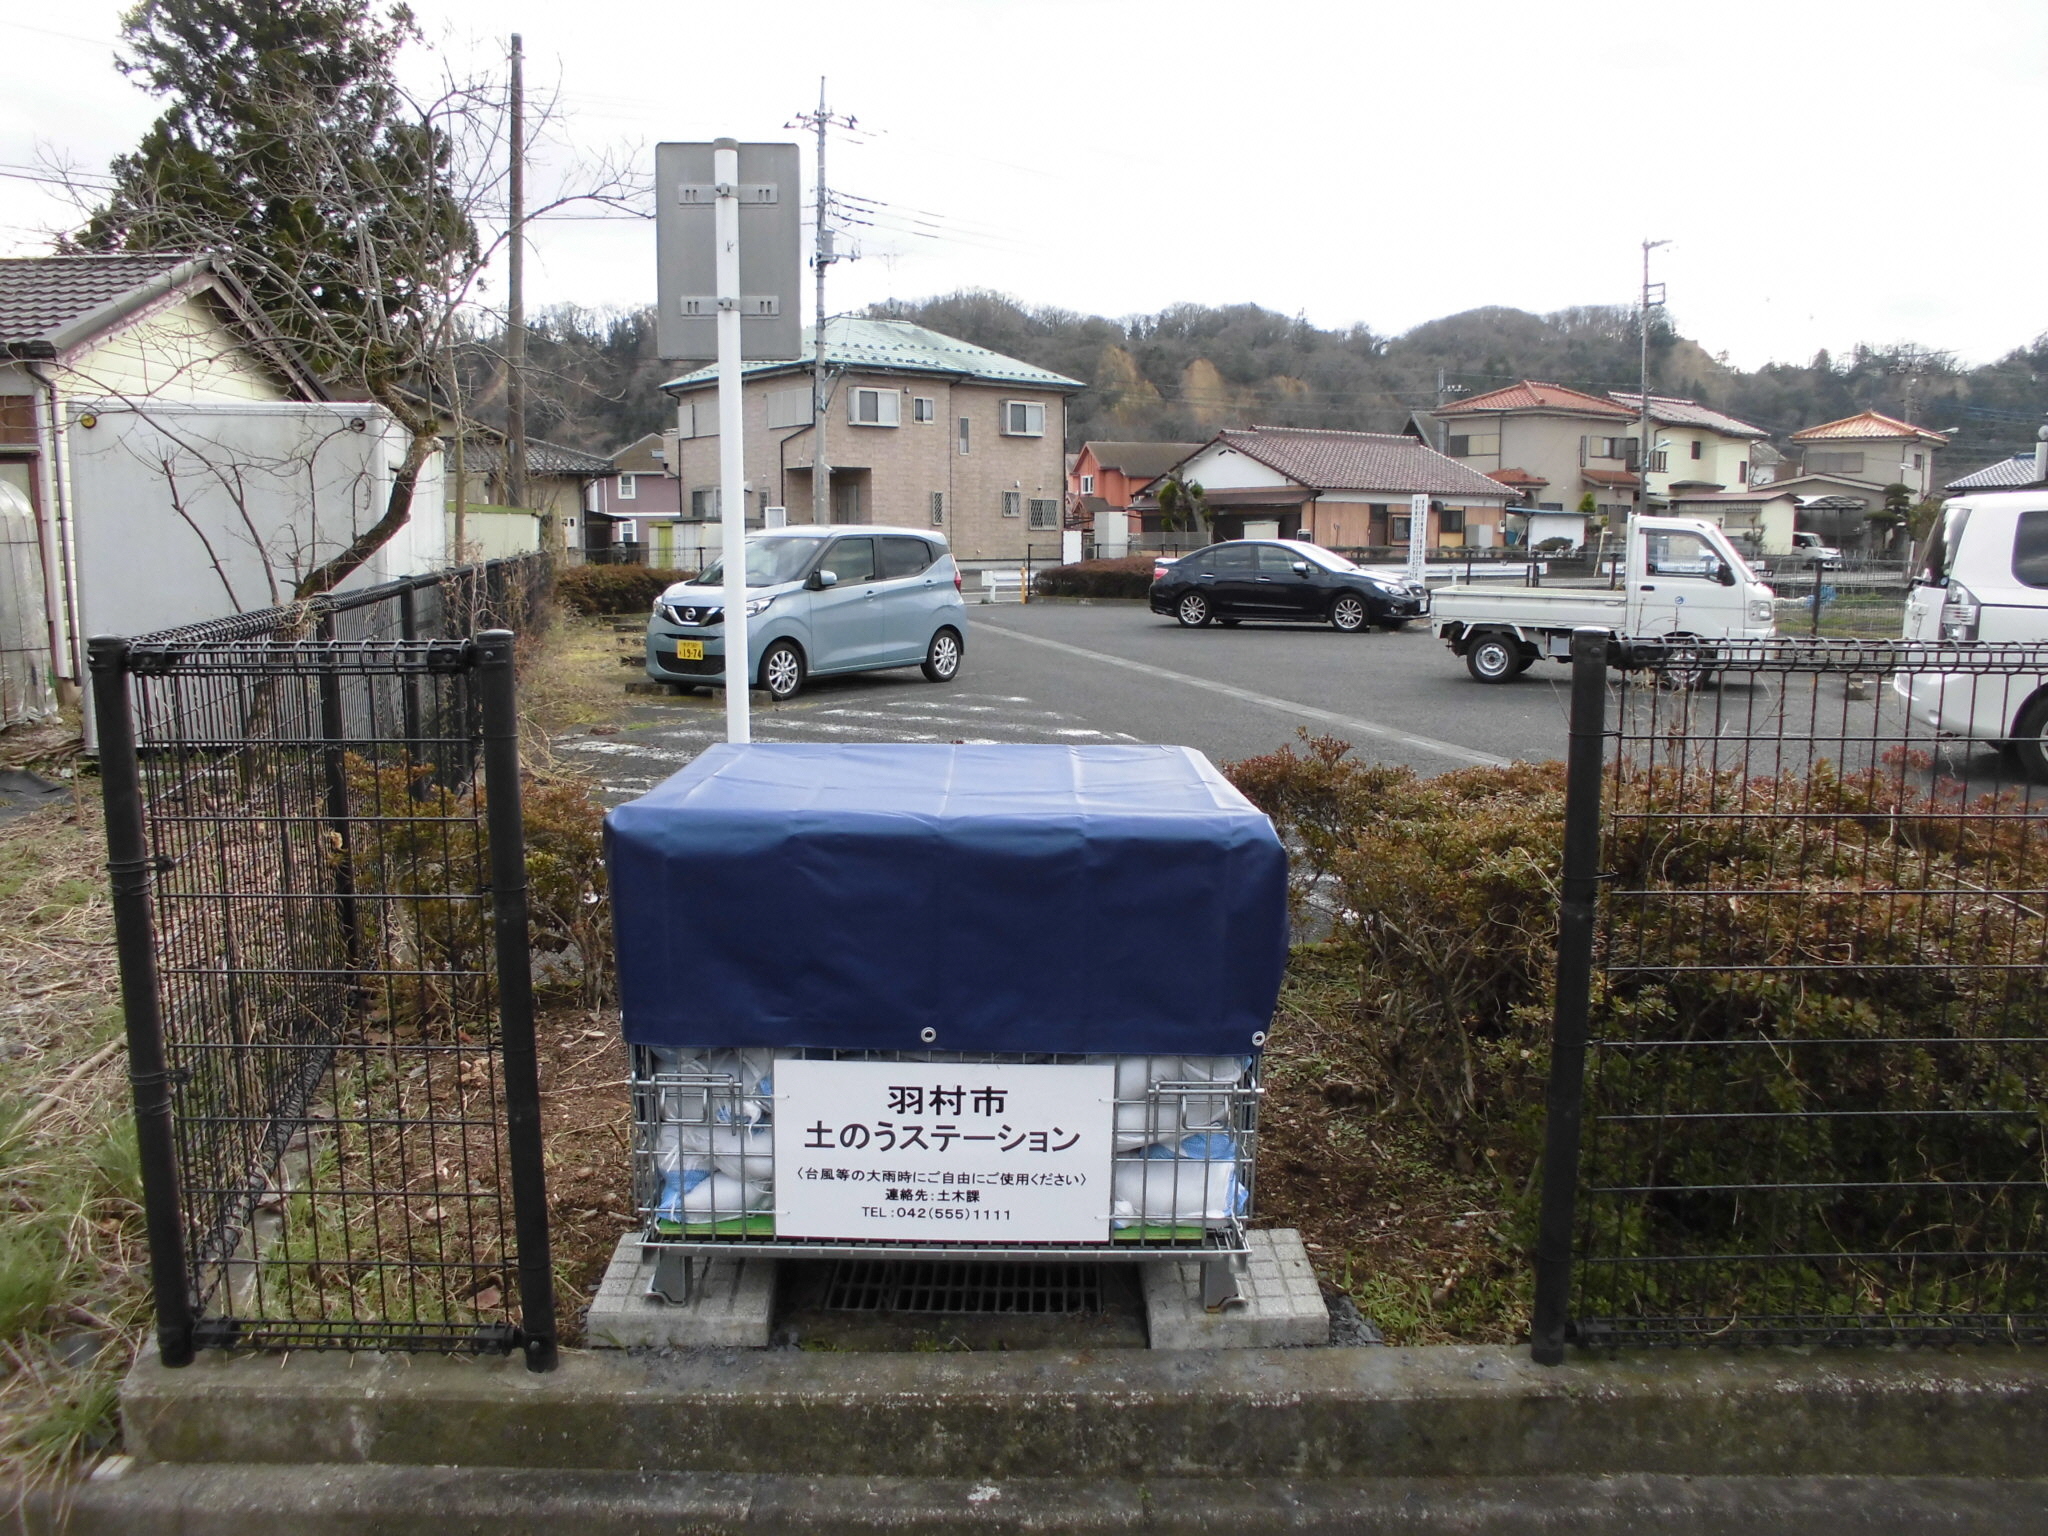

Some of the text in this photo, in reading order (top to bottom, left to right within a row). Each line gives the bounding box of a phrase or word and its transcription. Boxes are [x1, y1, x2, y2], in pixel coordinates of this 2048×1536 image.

[887, 1085, 1008, 1117] 羽村市
[804, 1120, 1081, 1152] 土のうステーション
[885, 1188, 980, 1203] 連絡先:土木課
